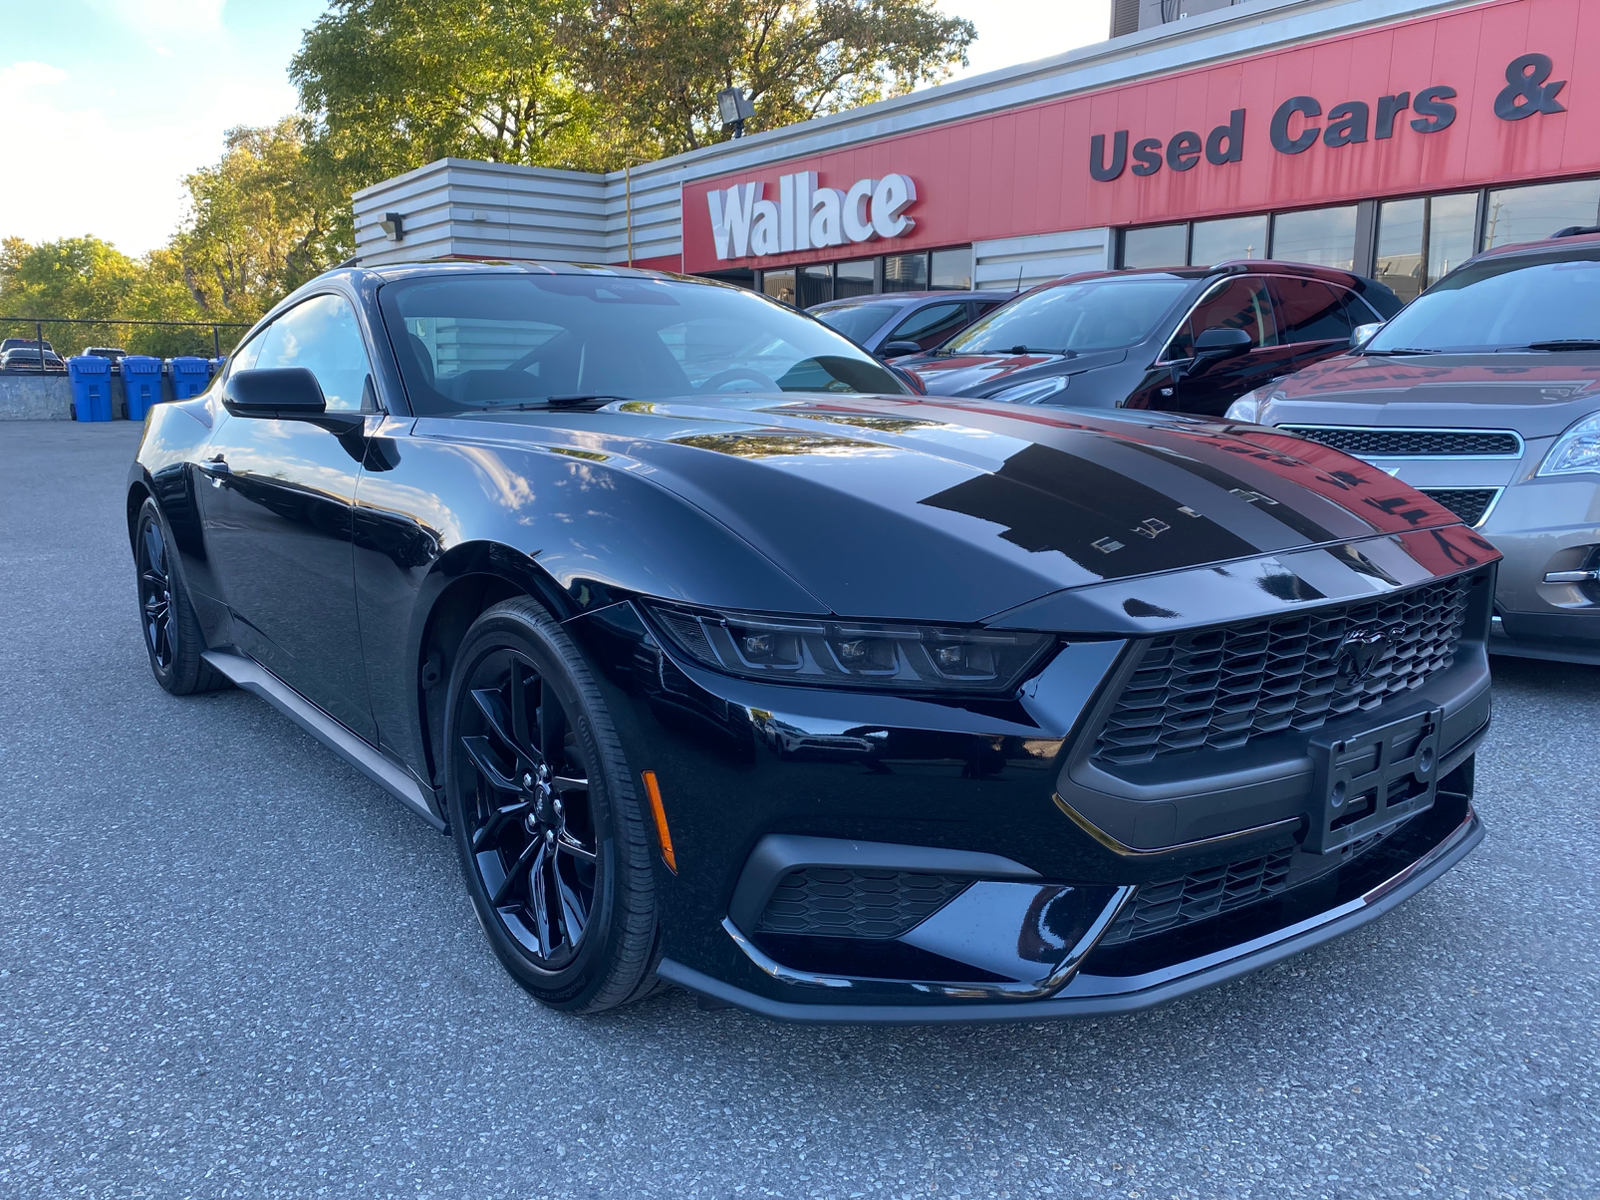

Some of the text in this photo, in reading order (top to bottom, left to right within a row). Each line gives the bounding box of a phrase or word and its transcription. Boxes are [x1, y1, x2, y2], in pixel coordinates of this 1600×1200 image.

[1089, 52, 1568, 182] Used Cars &
[707, 171, 916, 260] Wallace
